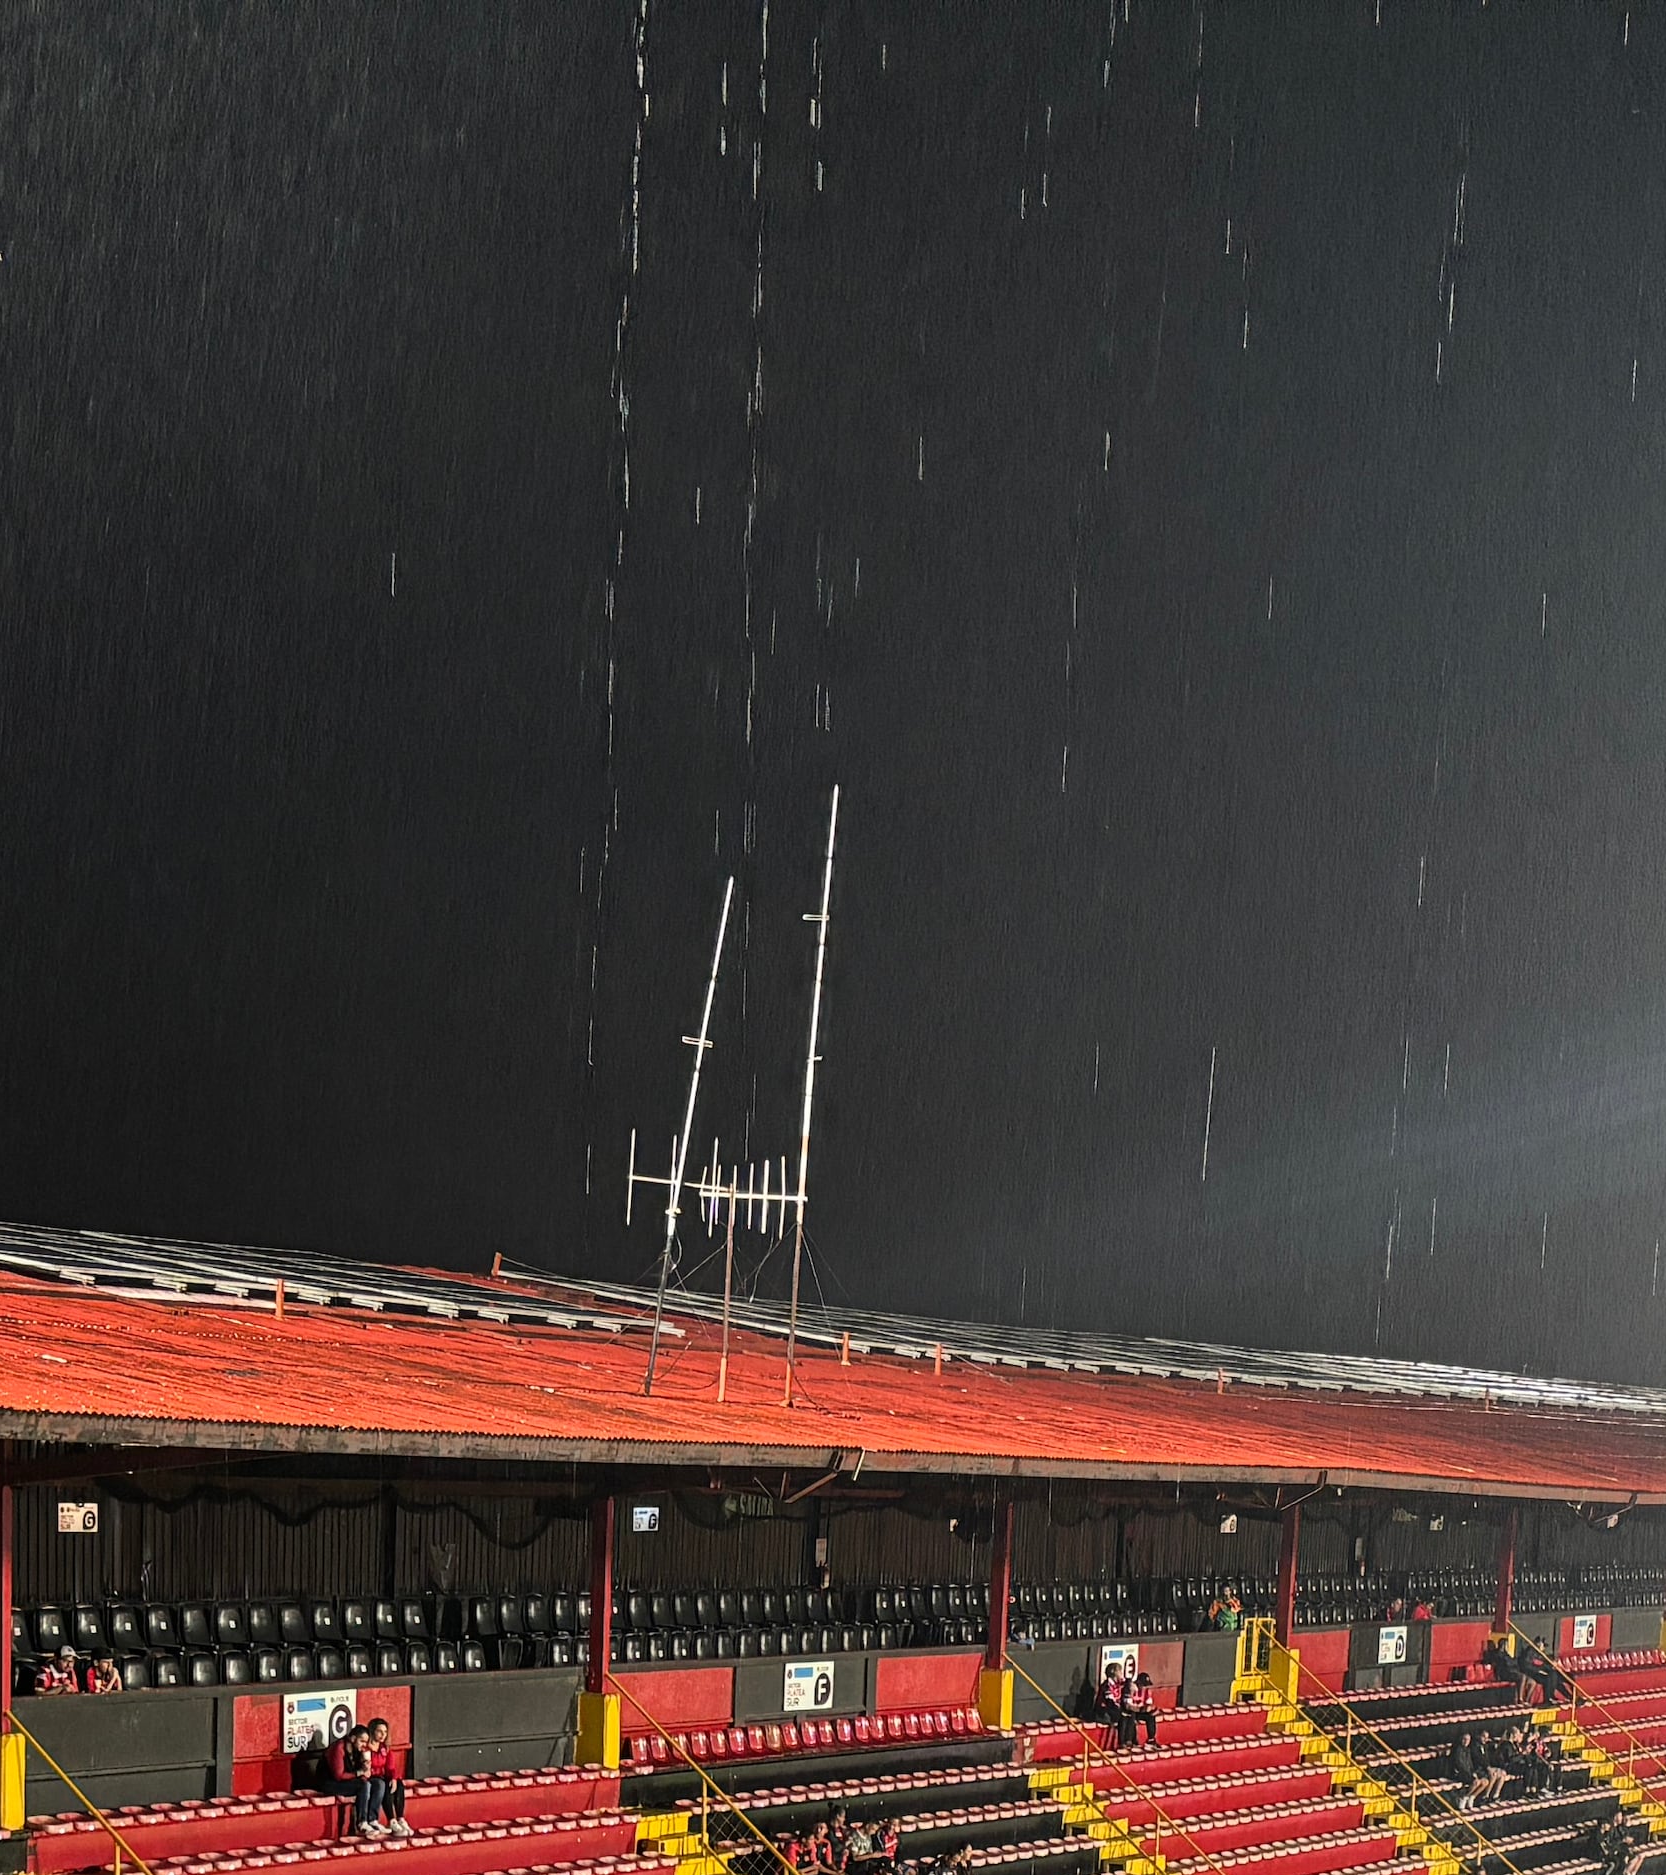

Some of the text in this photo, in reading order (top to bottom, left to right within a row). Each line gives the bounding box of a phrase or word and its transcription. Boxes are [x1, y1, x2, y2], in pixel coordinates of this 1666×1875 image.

[818, 1679, 828, 1702] F
[332, 1710, 348, 1739] G
[287, 1736, 308, 1749] SUR
